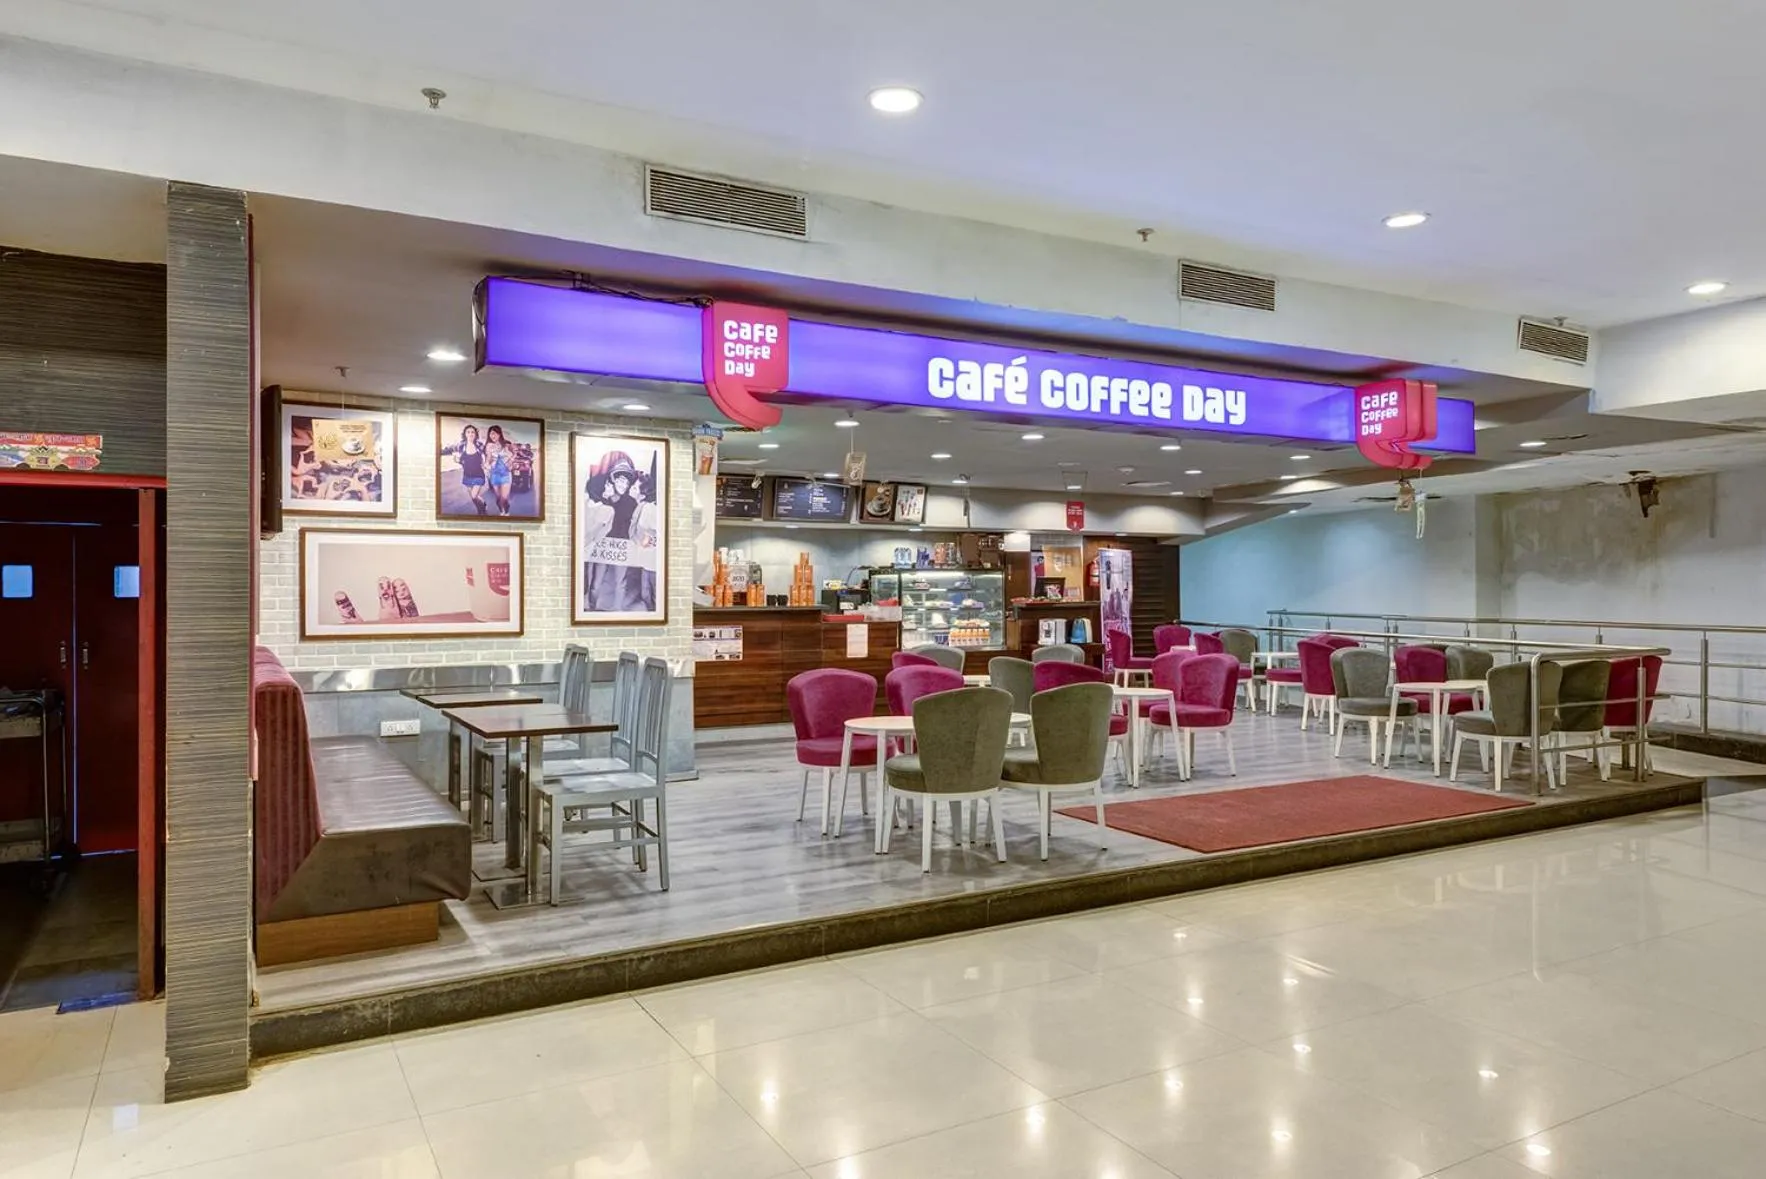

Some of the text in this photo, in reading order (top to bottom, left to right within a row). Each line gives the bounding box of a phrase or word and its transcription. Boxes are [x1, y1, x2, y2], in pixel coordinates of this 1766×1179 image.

[723, 319, 778, 343] Cafe
[724, 360, 755, 378] Day
[928, 356, 1247, 425] Café Coffee Day
[1361, 391, 1398, 410] Cafe
[1361, 407, 1399, 423] Coffee
[1361, 423, 1382, 436] Day
